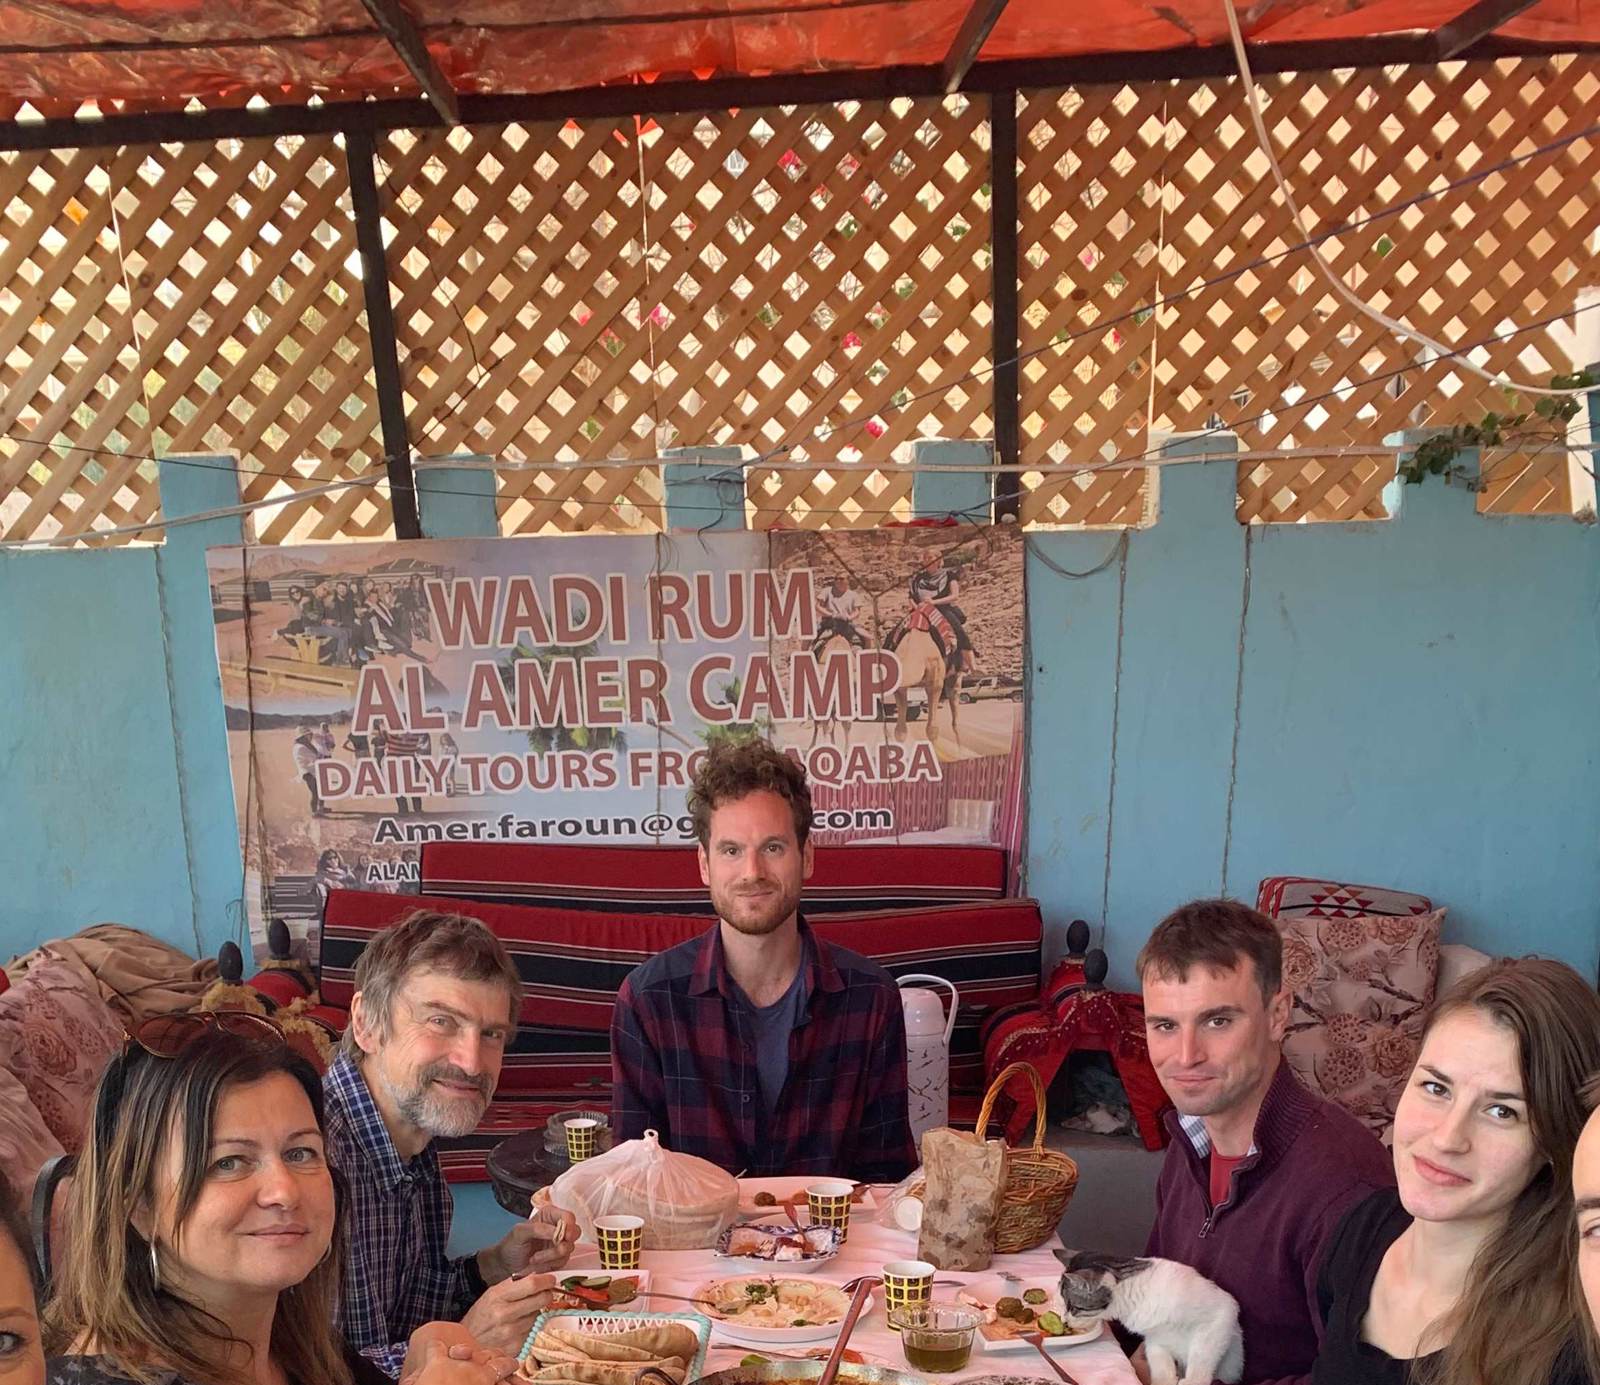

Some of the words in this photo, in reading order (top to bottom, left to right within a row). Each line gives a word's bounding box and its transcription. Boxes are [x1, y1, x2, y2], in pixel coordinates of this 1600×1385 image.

[426, 574, 627, 647] WADI
[648, 570, 815, 641] RUM
[354, 665, 446, 732] AL
[463, 656, 673, 728] AMER
[689, 652, 900, 721] CAMP
[317, 757, 451, 797] DAILY
[460, 752, 617, 792] TOURS
[629, 749, 709, 787] FR
